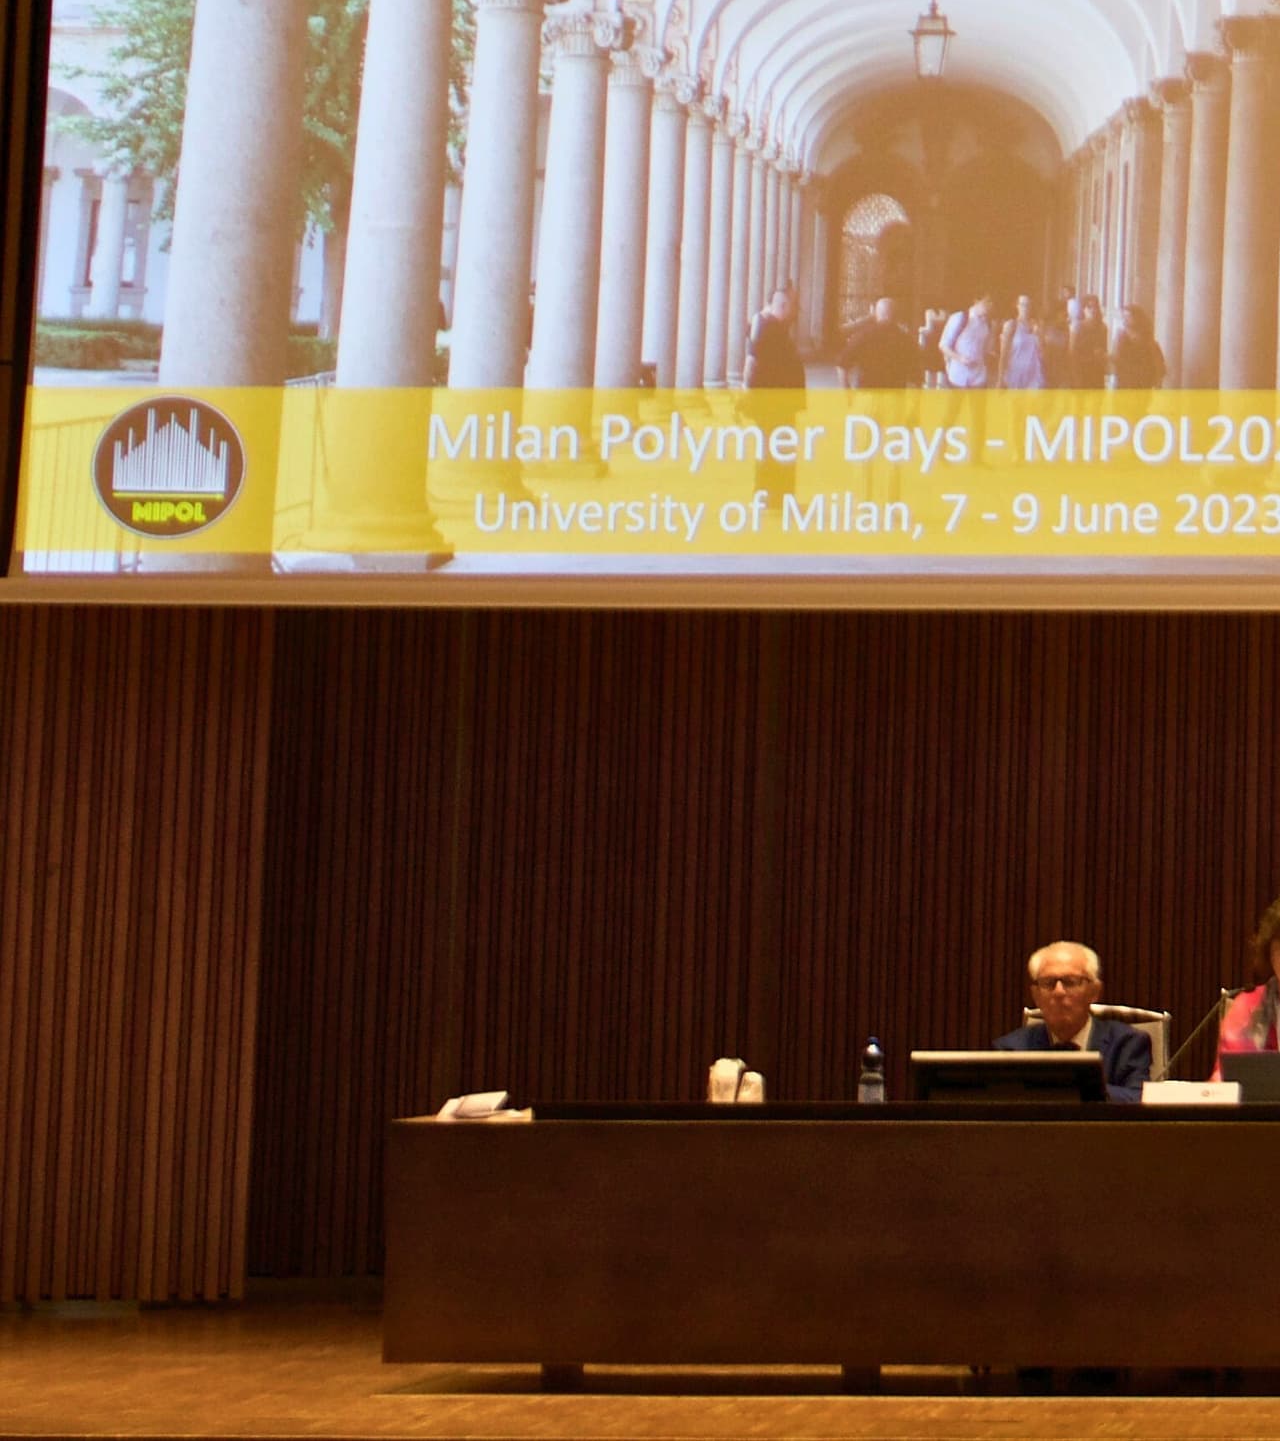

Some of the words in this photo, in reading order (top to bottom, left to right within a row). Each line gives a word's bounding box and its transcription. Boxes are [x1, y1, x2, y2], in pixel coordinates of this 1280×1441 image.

[428, 411, 579, 462] Milan
[600, 411, 825, 472] Polymer
[844, 414, 969, 473] Days
[132, 501, 207, 522] MIPOL
[474, 492, 705, 542] University
[719, 490, 769, 533] of
[781, 492, 923, 541] Milan,
[940, 494, 968, 533] 7
[1011, 493, 1039, 534] 9
[1051, 493, 1160, 534] June
